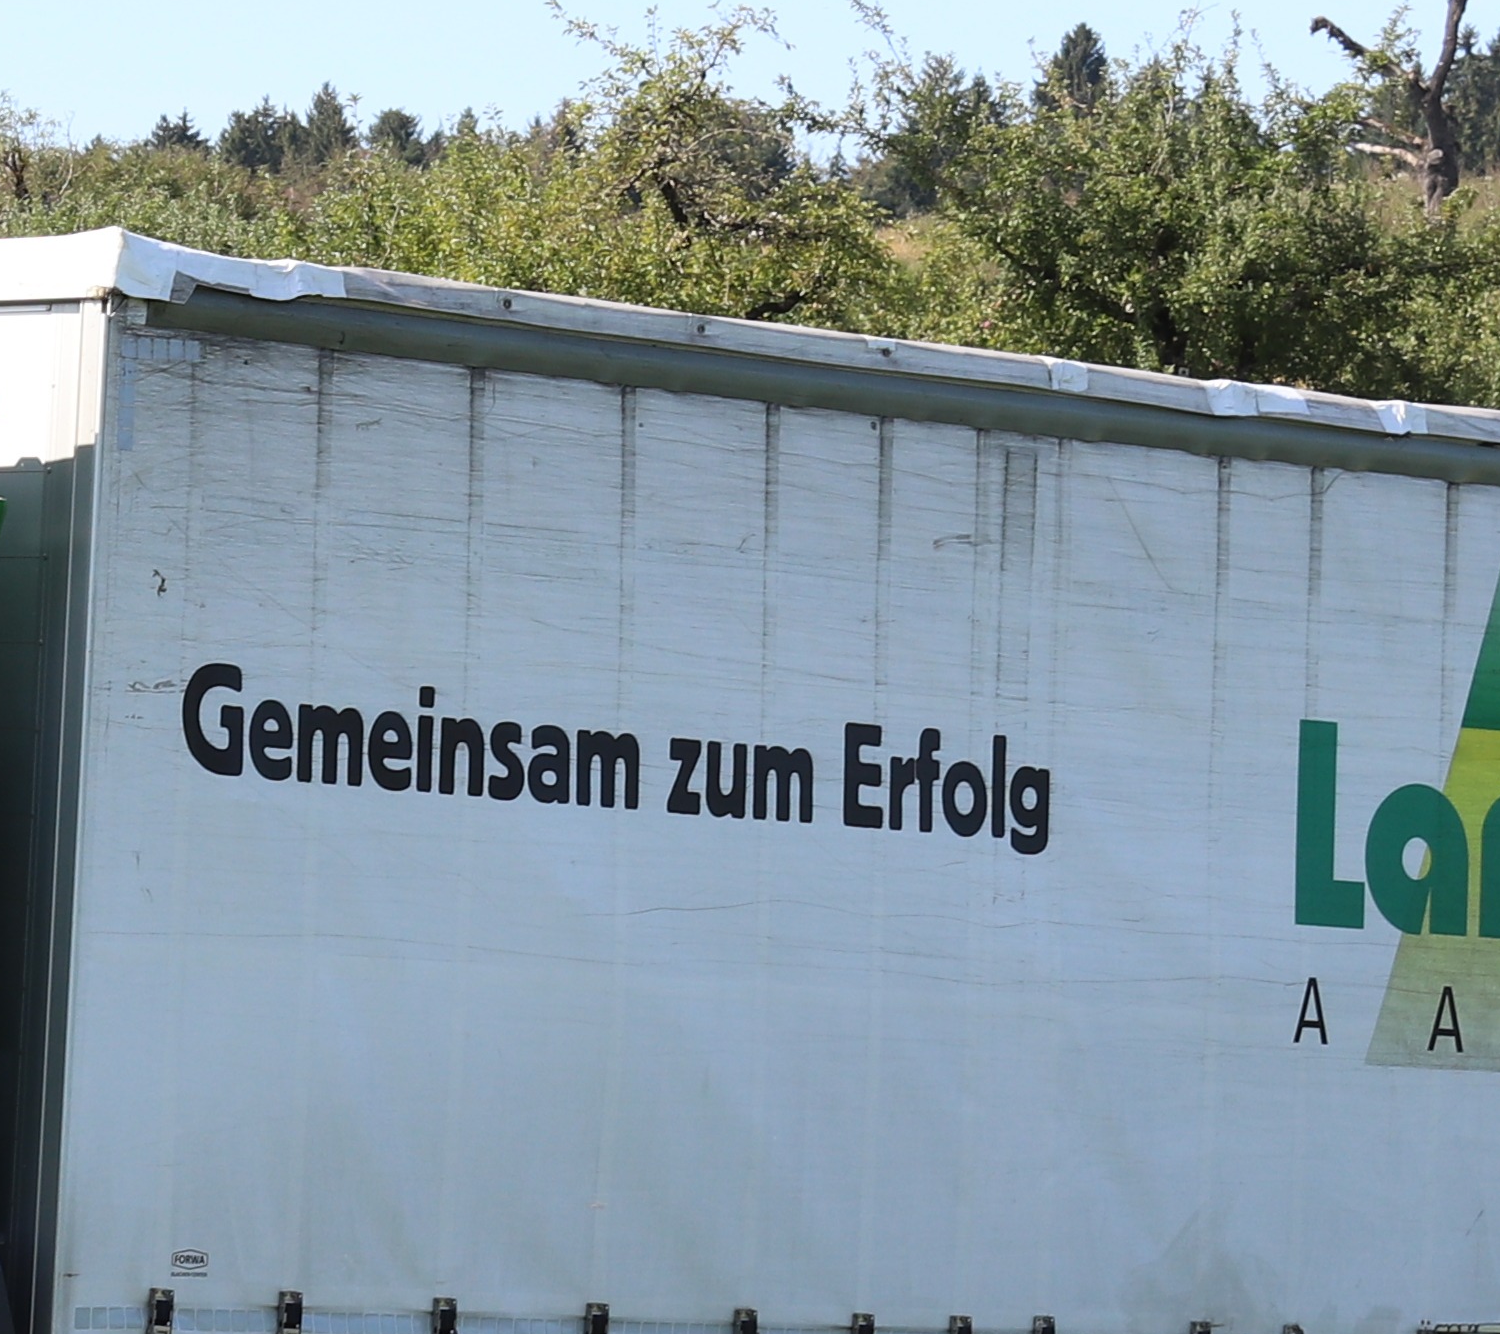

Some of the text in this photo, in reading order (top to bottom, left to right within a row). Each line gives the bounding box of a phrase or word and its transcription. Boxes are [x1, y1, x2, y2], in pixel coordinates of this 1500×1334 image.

[182, 662, 1051, 855] Gemeinsam zum Erfolg
